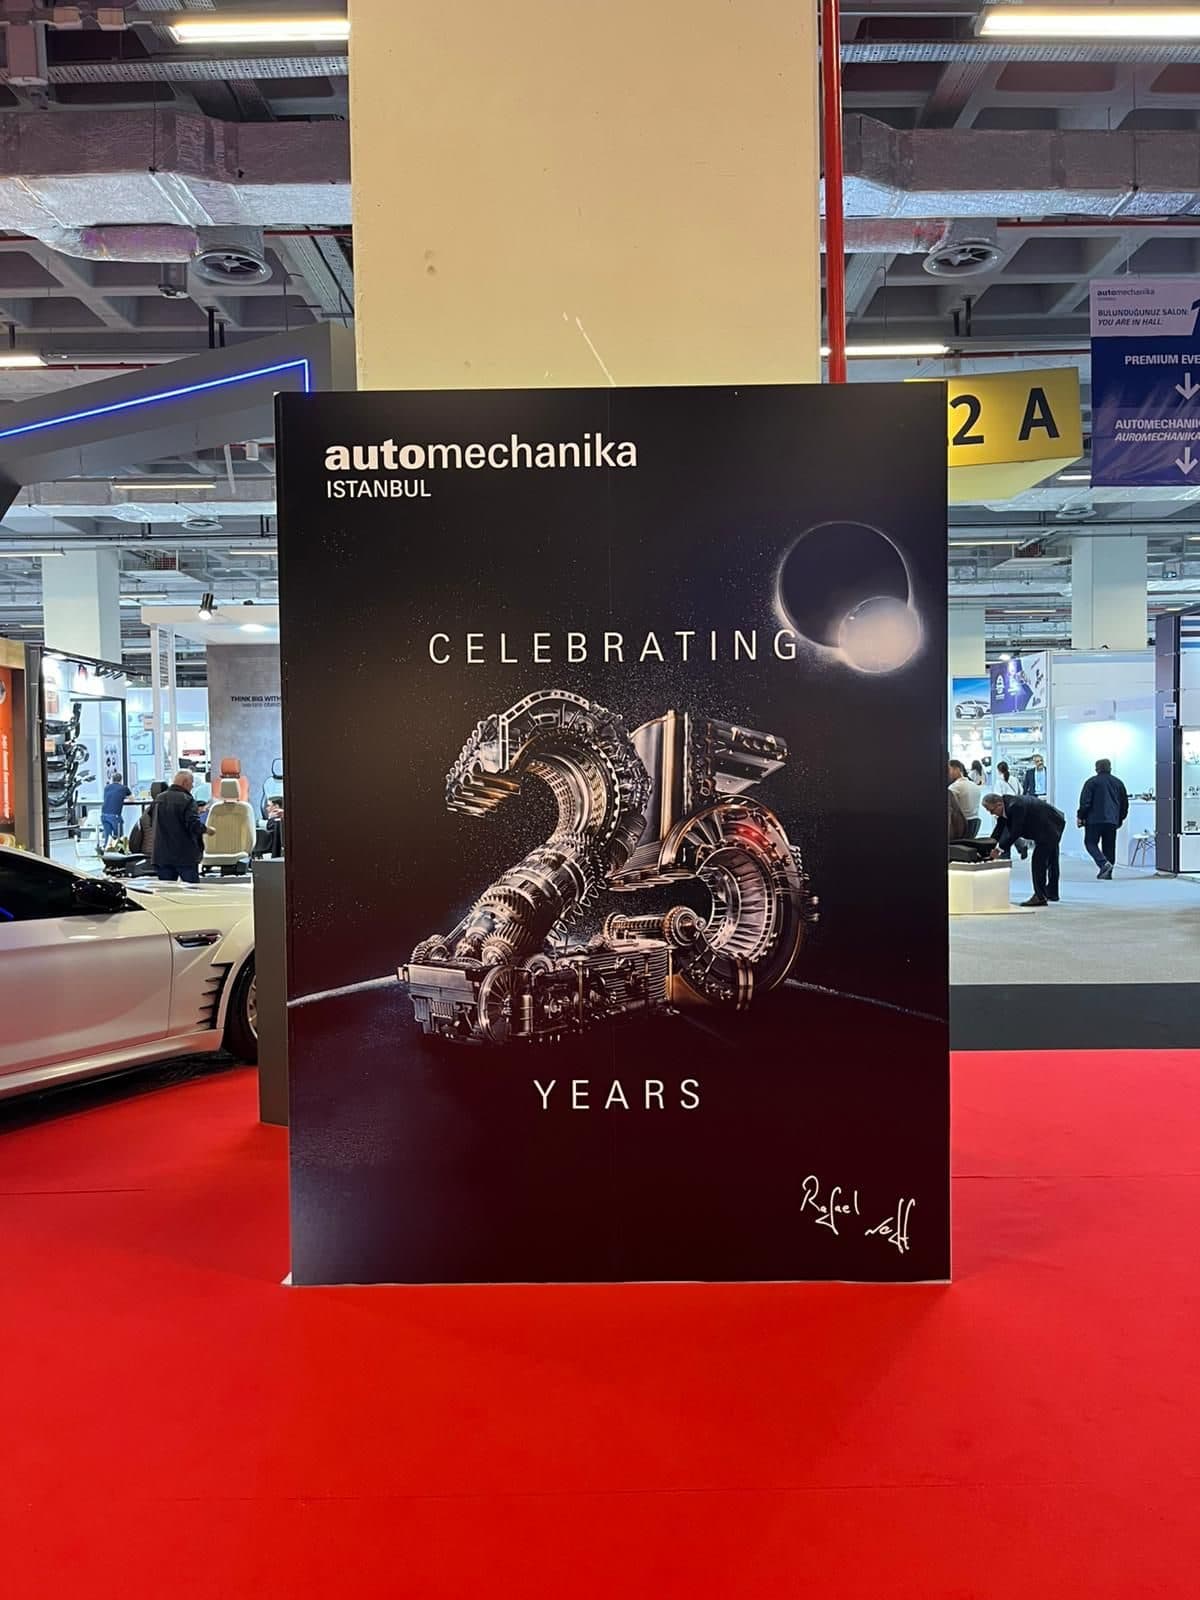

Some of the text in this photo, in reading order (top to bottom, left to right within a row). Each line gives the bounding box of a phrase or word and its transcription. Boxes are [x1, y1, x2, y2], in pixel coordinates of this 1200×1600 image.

[1098, 318, 1114, 327] YOU
[1115, 318, 1130, 326] ARE
[1131, 318, 1140, 326] IN
[1124, 354, 1179, 365] PREMIUM
[947, 387, 1060, 446] 2 A
[324, 432, 638, 470] automechanika
[326, 479, 432, 498] ISTANBUL
[428, 629, 797, 664] CELEBRATING
[533, 1078, 700, 1110] YEARS
[800, 1175, 860, 1236] Rafael
